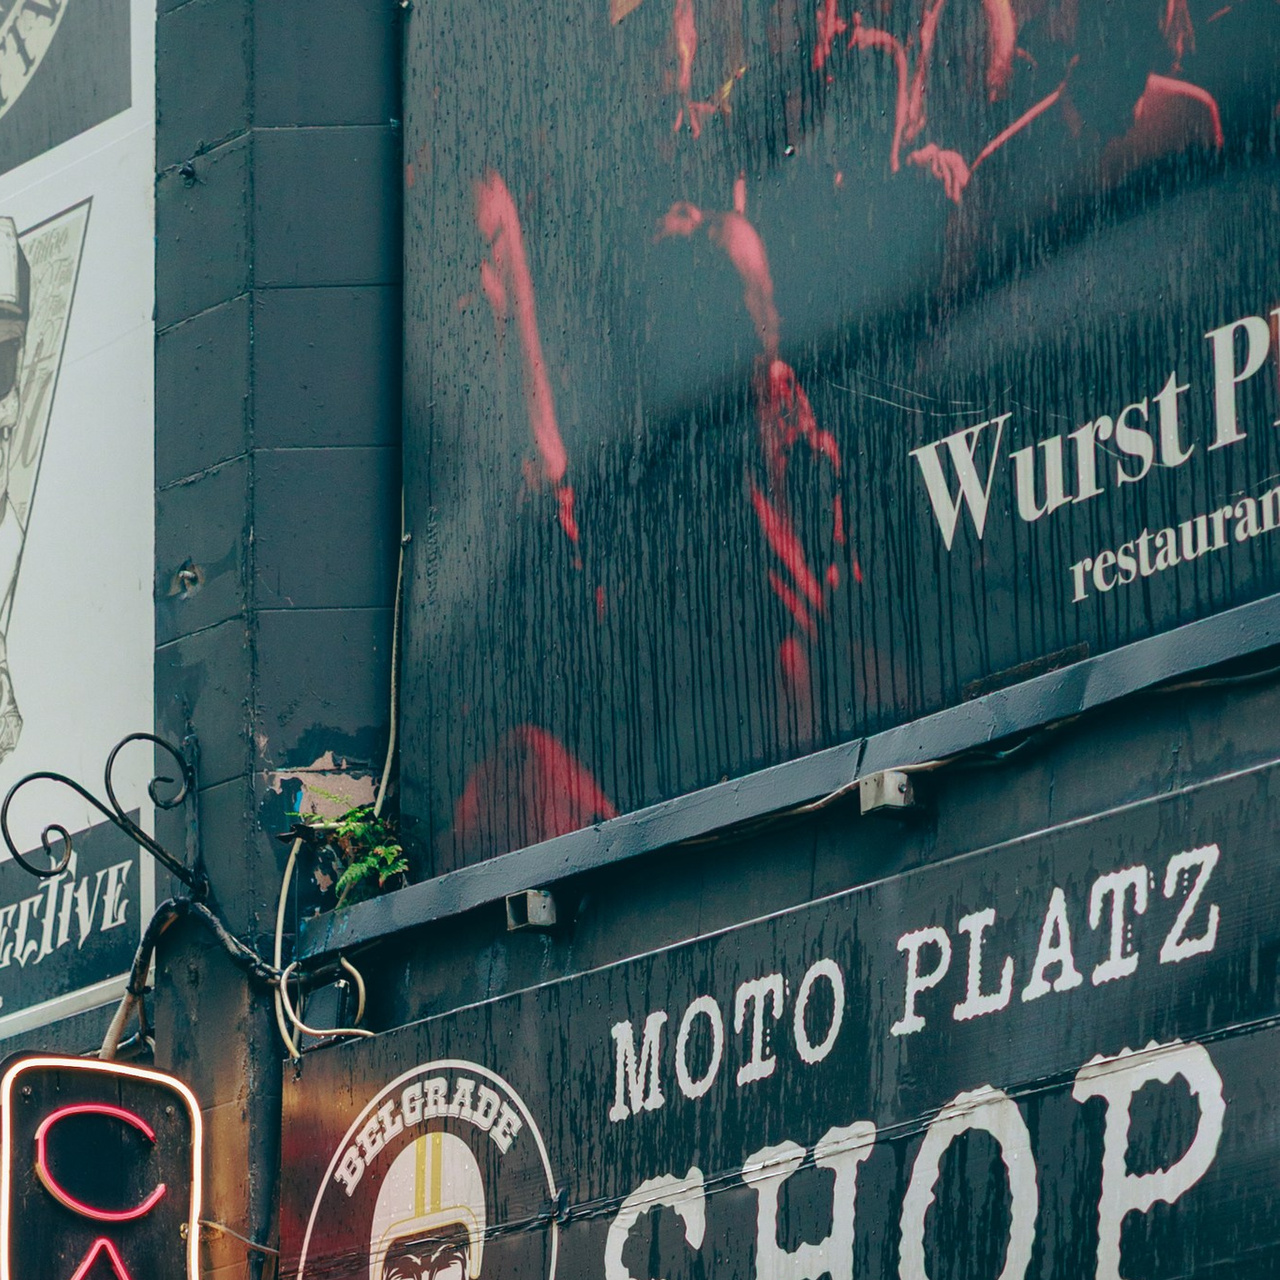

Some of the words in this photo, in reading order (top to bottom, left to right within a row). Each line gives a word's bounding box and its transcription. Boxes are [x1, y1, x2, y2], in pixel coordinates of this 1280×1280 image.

[908, 370, 1196, 552] Wurst
[609, 957, 845, 1122] MOTO
[890, 843, 1220, 1036] PLATZ
[333, 1076, 523, 1198] BELGRADE
